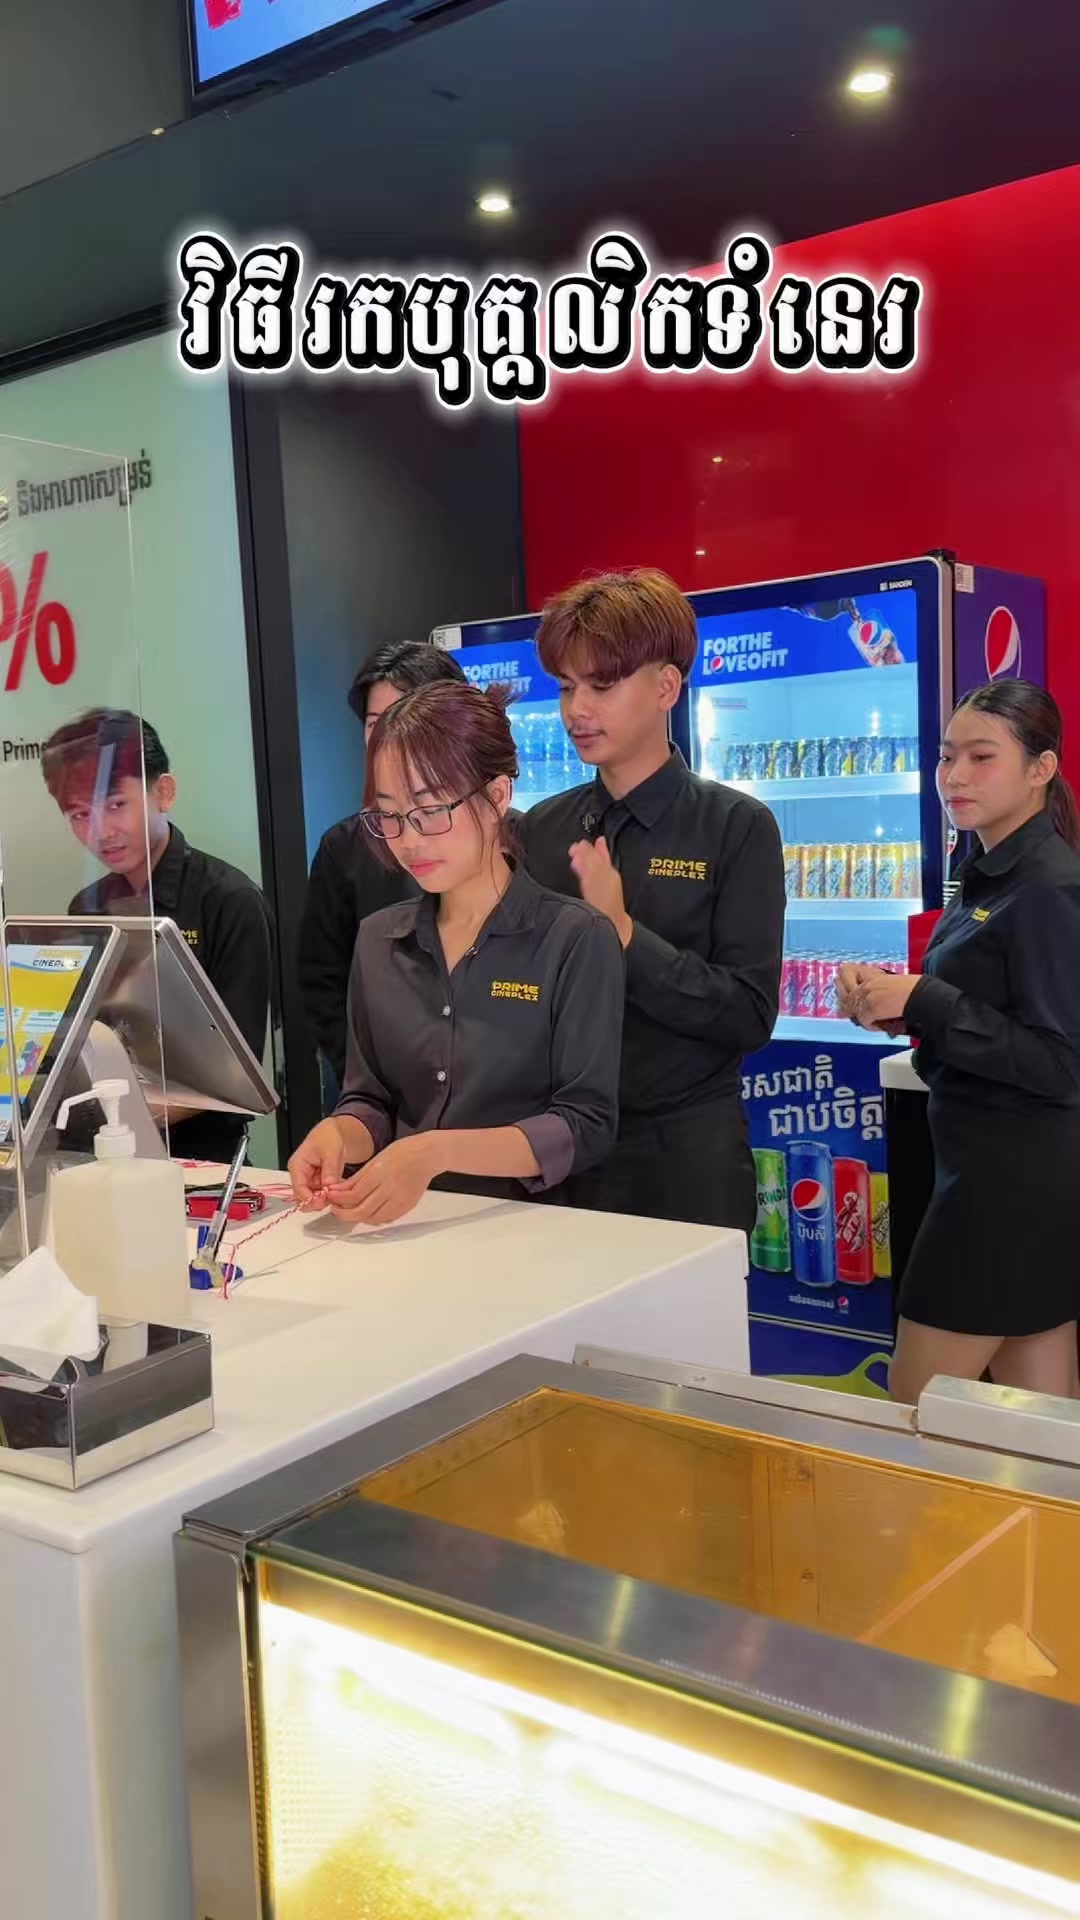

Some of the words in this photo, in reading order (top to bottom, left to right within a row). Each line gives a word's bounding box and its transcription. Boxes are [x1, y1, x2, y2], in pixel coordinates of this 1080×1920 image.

[650, 858, 707, 872] PRIME
[648, 868, 706, 880] CINEPLEX
[32, 959, 81, 968] CINEPLX
[492, 981, 539, 995] PRIME
[490, 990, 538, 1002] CINEPLEX
